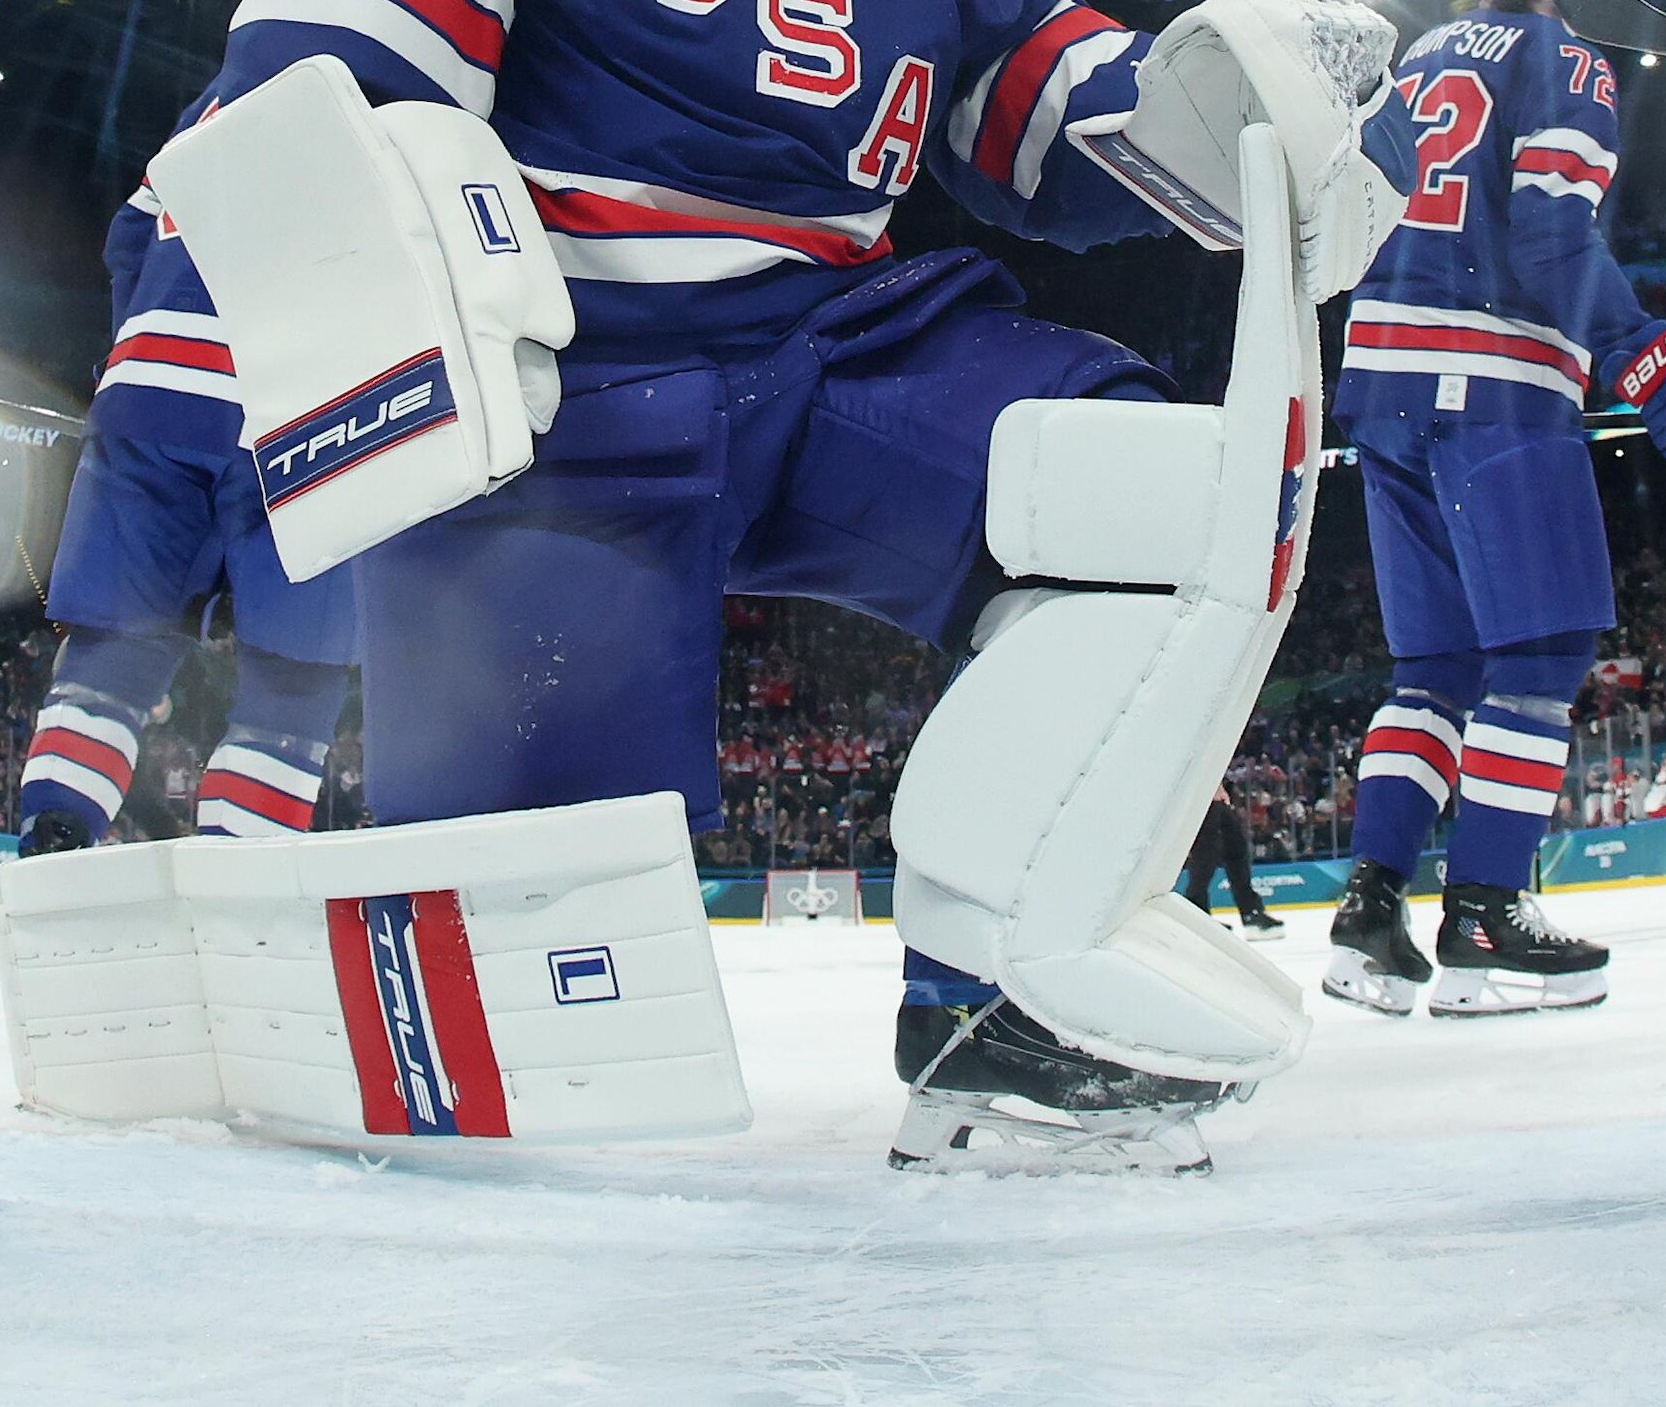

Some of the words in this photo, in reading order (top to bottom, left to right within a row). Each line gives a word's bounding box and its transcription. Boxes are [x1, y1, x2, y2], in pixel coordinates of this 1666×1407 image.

[1560, 44, 1617, 113] 72
[266, 381, 434, 476] TRUE
[1320, 447, 1358, 469] IT'S
[375, 911, 439, 1126] TRUE
